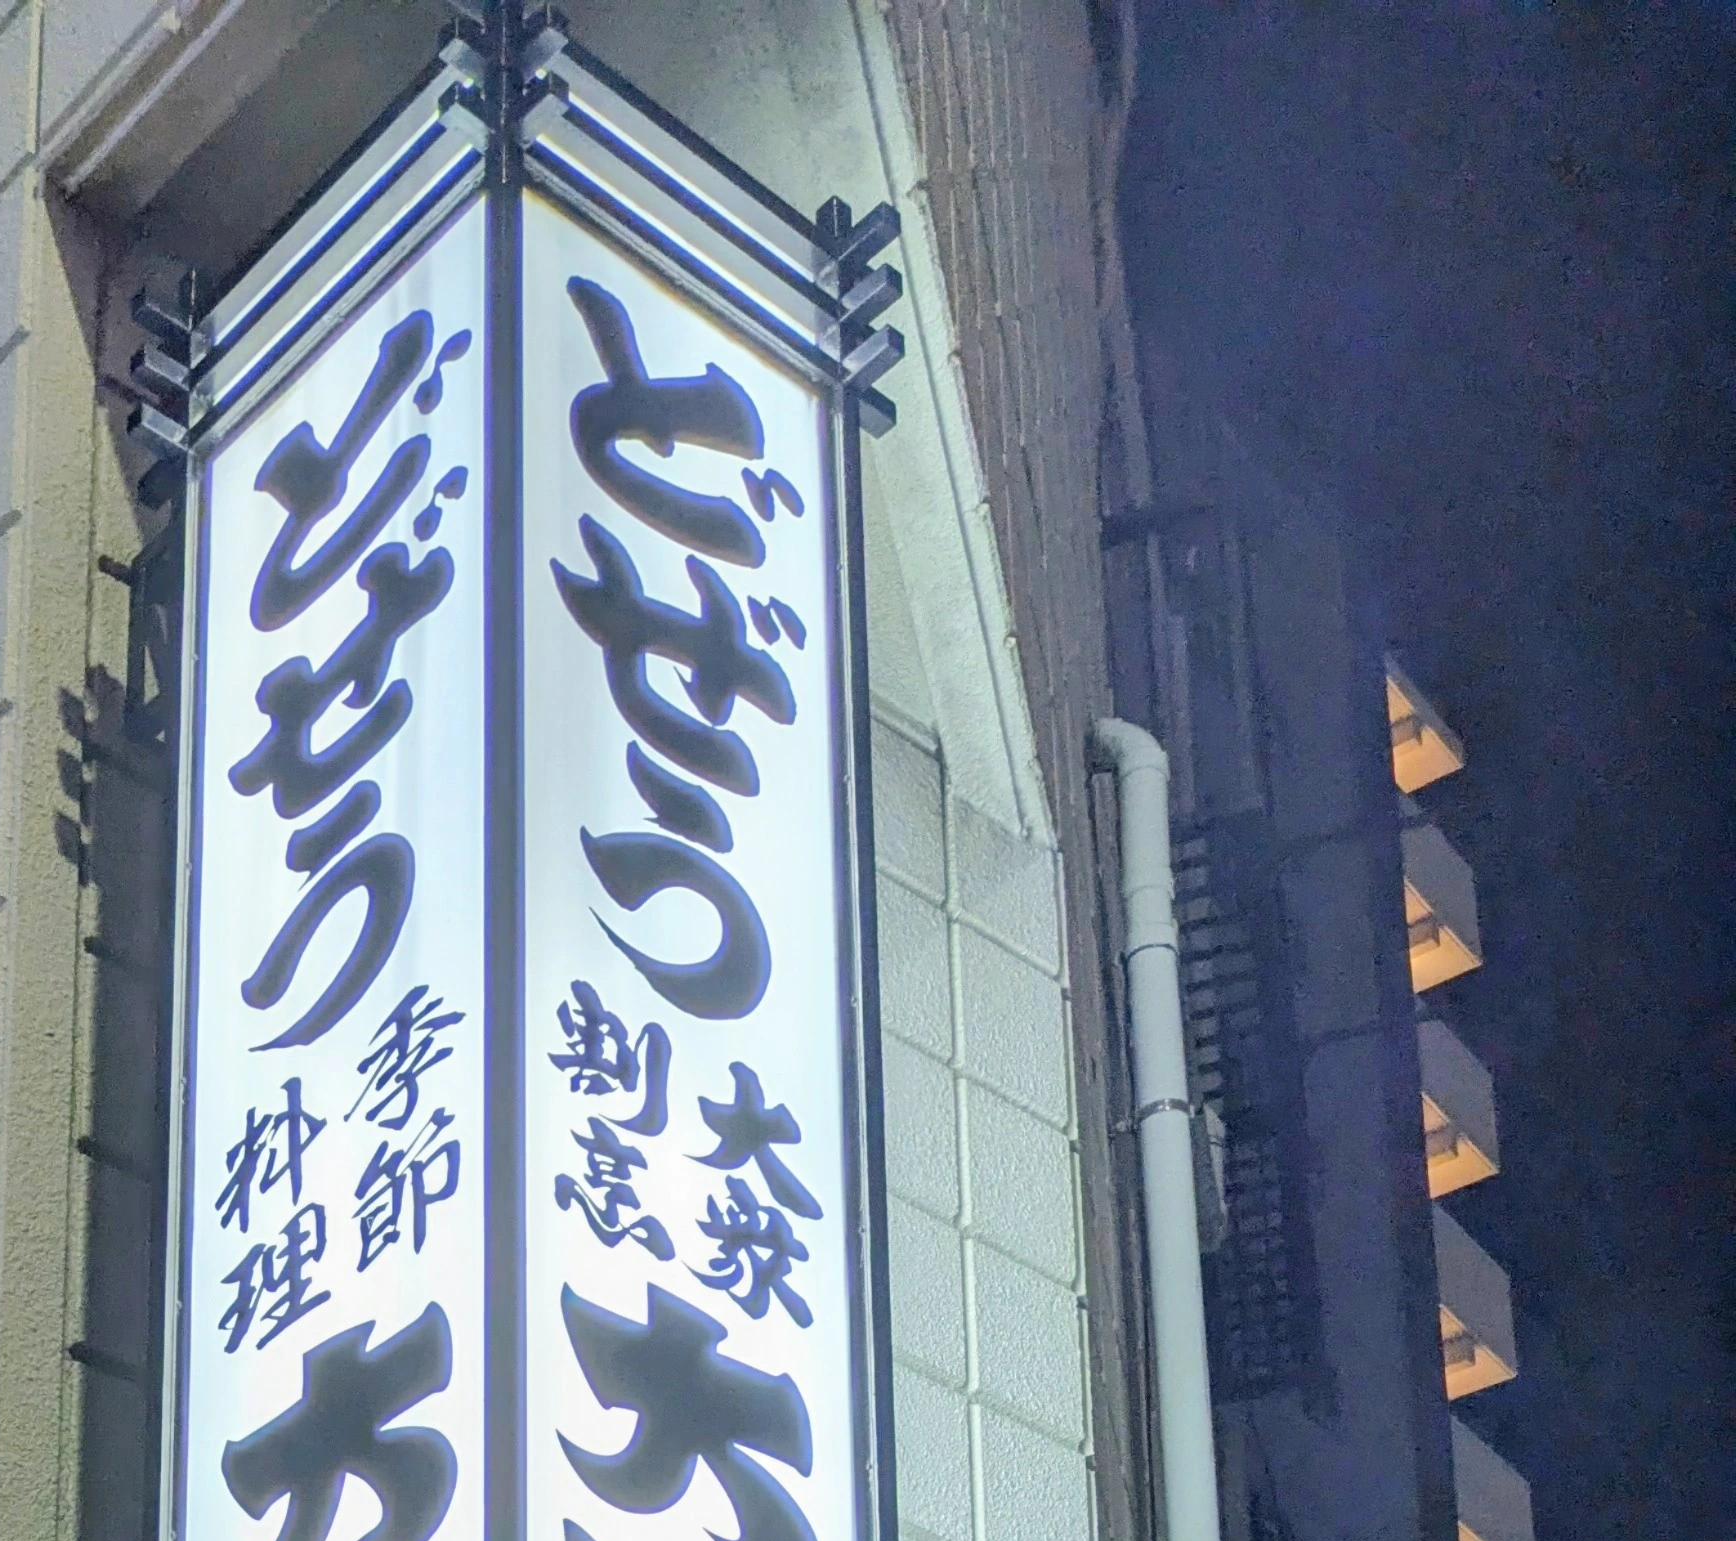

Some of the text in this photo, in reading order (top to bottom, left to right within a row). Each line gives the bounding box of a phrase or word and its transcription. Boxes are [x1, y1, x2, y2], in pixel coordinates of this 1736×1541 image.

[228, 308, 472, 1052] どぜう
[549, 275, 807, 1020] どぜう
[214, 1076, 329, 1353] 料理
[344, 983, 466, 1272] 季節
[681, 1061, 824, 1328] 大衆
